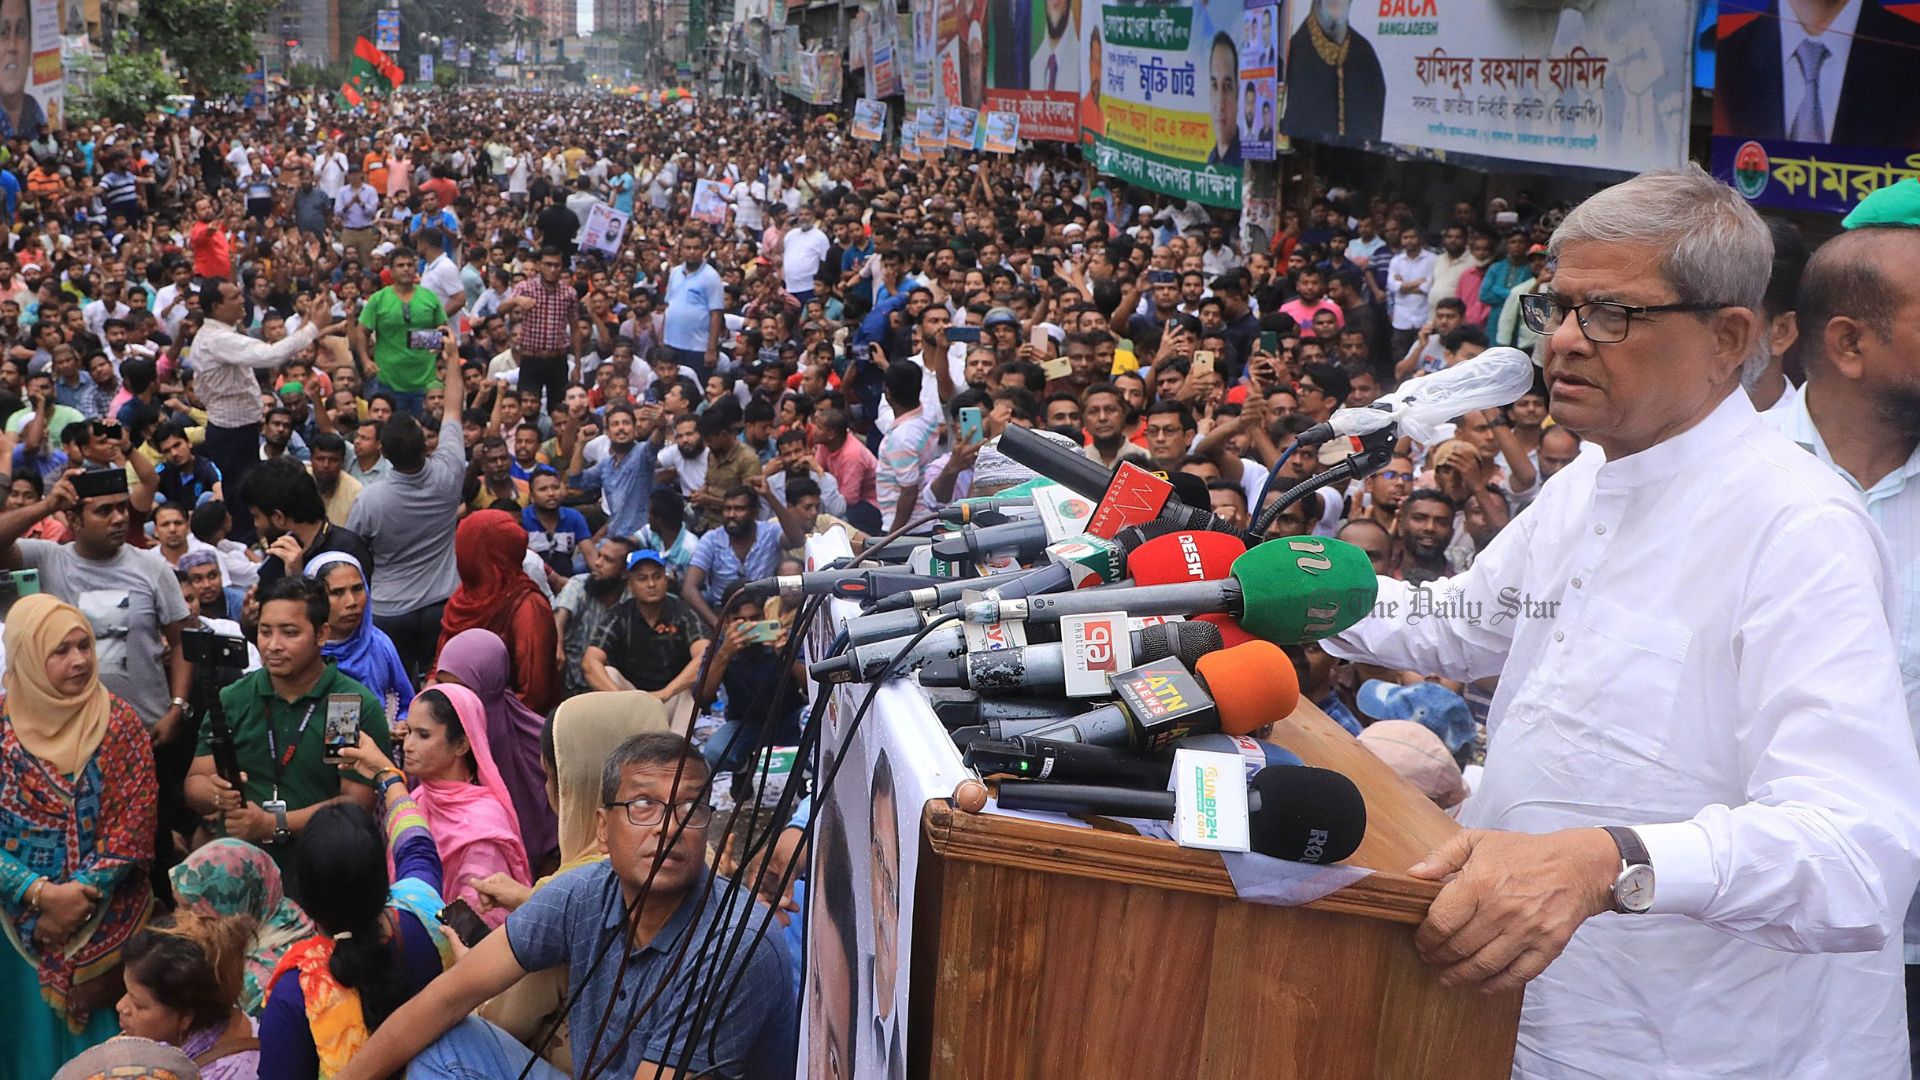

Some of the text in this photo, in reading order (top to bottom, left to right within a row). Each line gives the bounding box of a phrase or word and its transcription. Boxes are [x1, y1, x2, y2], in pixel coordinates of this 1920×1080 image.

[1378, 21, 1439, 35] BANGLADESH
[1139, 57, 1168, 101] মুক্তি
[1171, 61, 1196, 96] চাই
[1414, 46, 1609, 94] হামিদুর রহমান হামিদ
[1547, 98, 1604, 129] (বিএনপি)
[1147, 160, 1192, 193] মহানগর
[1194, 164, 1238, 201] দক্ষিণ
[1132, 680, 1166, 716] NEWS
[1144, 675, 1190, 712] ATN
